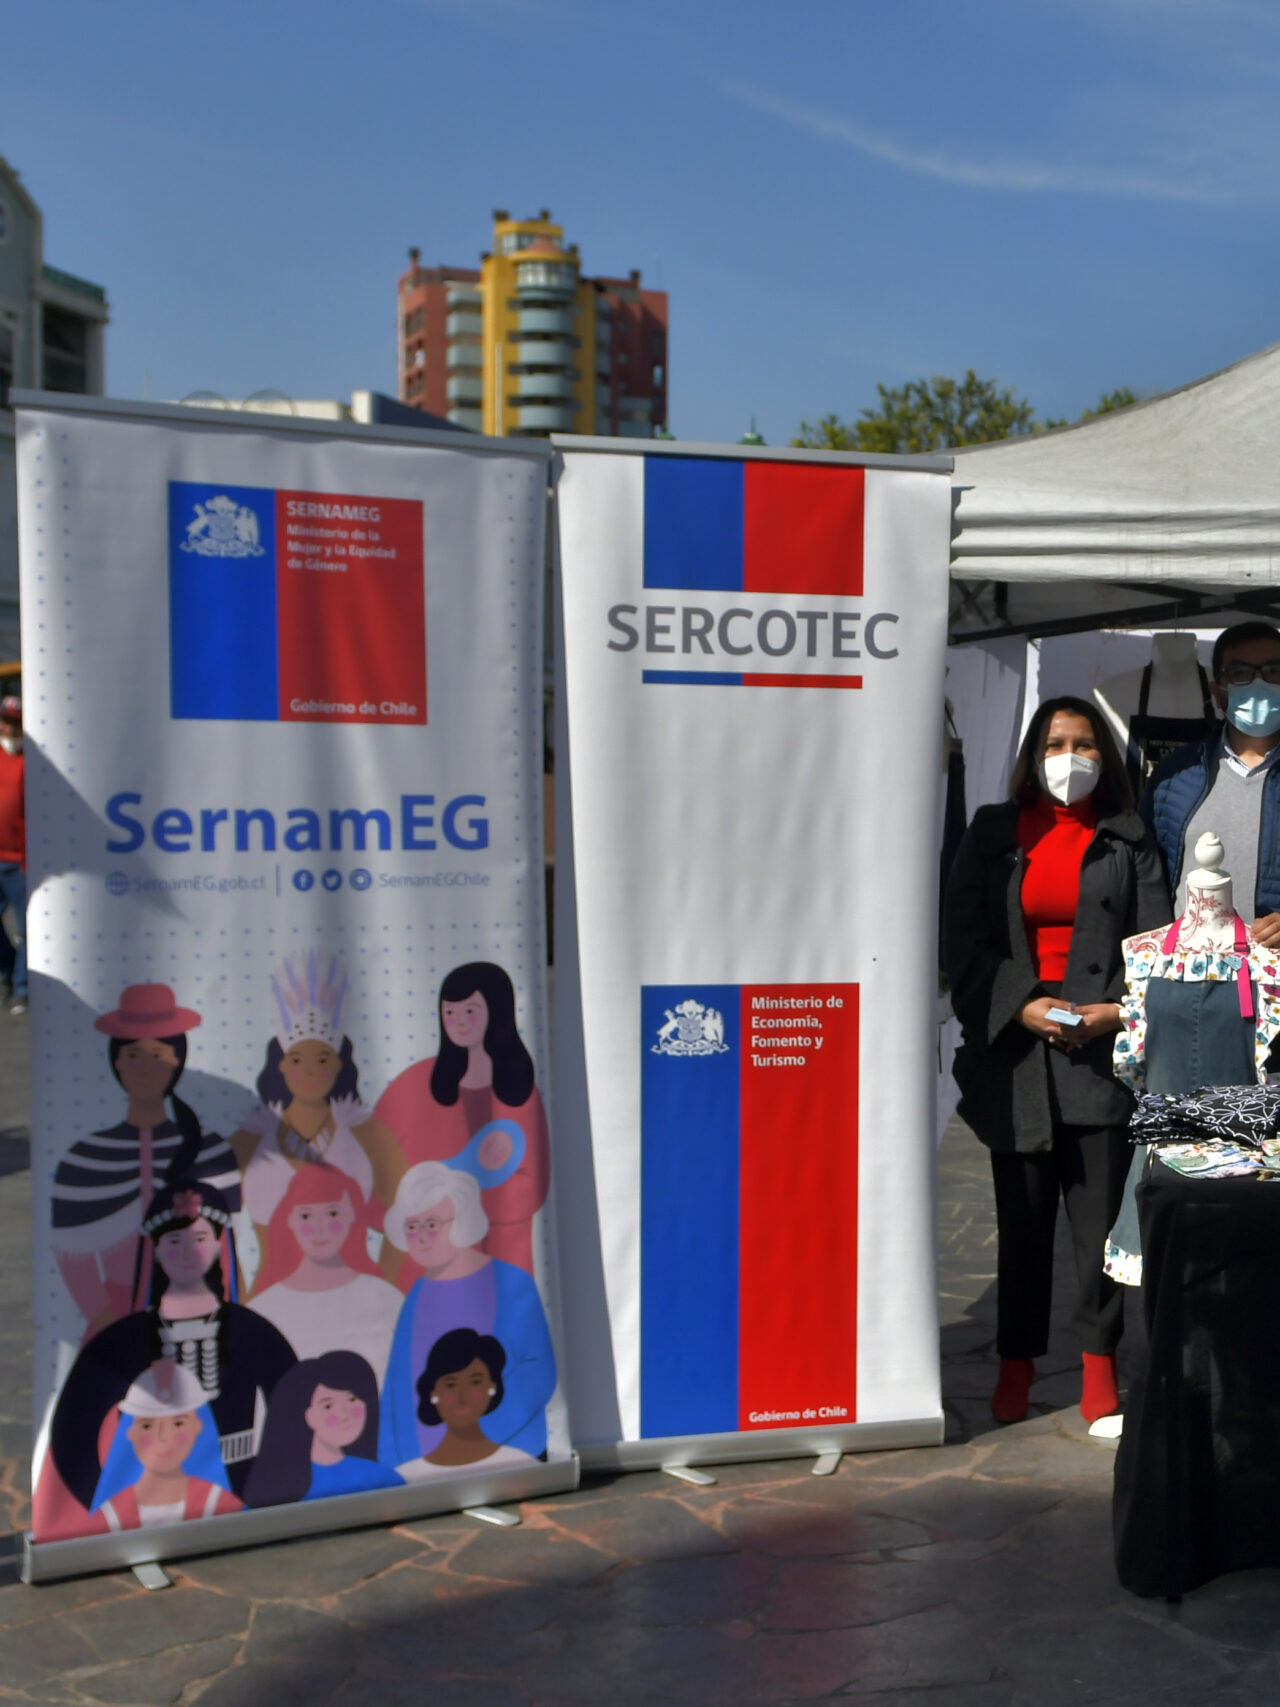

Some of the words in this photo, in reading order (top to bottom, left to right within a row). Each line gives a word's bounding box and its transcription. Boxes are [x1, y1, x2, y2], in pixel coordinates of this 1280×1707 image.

[286, 500, 381, 522] SERNAMEG
[287, 524, 348, 539] Ministerio
[351, 528, 366, 540] de
[369, 529, 380, 541] la
[287, 540, 322, 556] Mujer
[324, 547, 333, 558] y
[335, 543, 346, 556] la
[349, 545, 397, 559] Equidad
[288, 556, 303, 569] de
[305, 557, 348, 572] Género
[606, 603, 900, 660] SERCOTEC
[290, 698, 356, 716] Gobierno
[359, 700, 377, 715] de
[380, 700, 417, 717] Chile
[105, 792, 490, 853] SernamEG
[133, 875, 266, 893] SernamEG.gob.cl
[379, 872, 490, 888] SernamEGChile
[751, 997, 823, 1010] Ministerio
[826, 996, 844, 1008] de
[751, 1014, 823, 1029] Economía,
[751, 1035, 812, 1048] Fomento
[814, 1036, 824, 1050] y
[751, 1054, 806, 1067] Turismo
[749, 1410, 801, 1423] Gobierno
[802, 1408, 817, 1419] de
[818, 1406, 848, 1418] Chile
